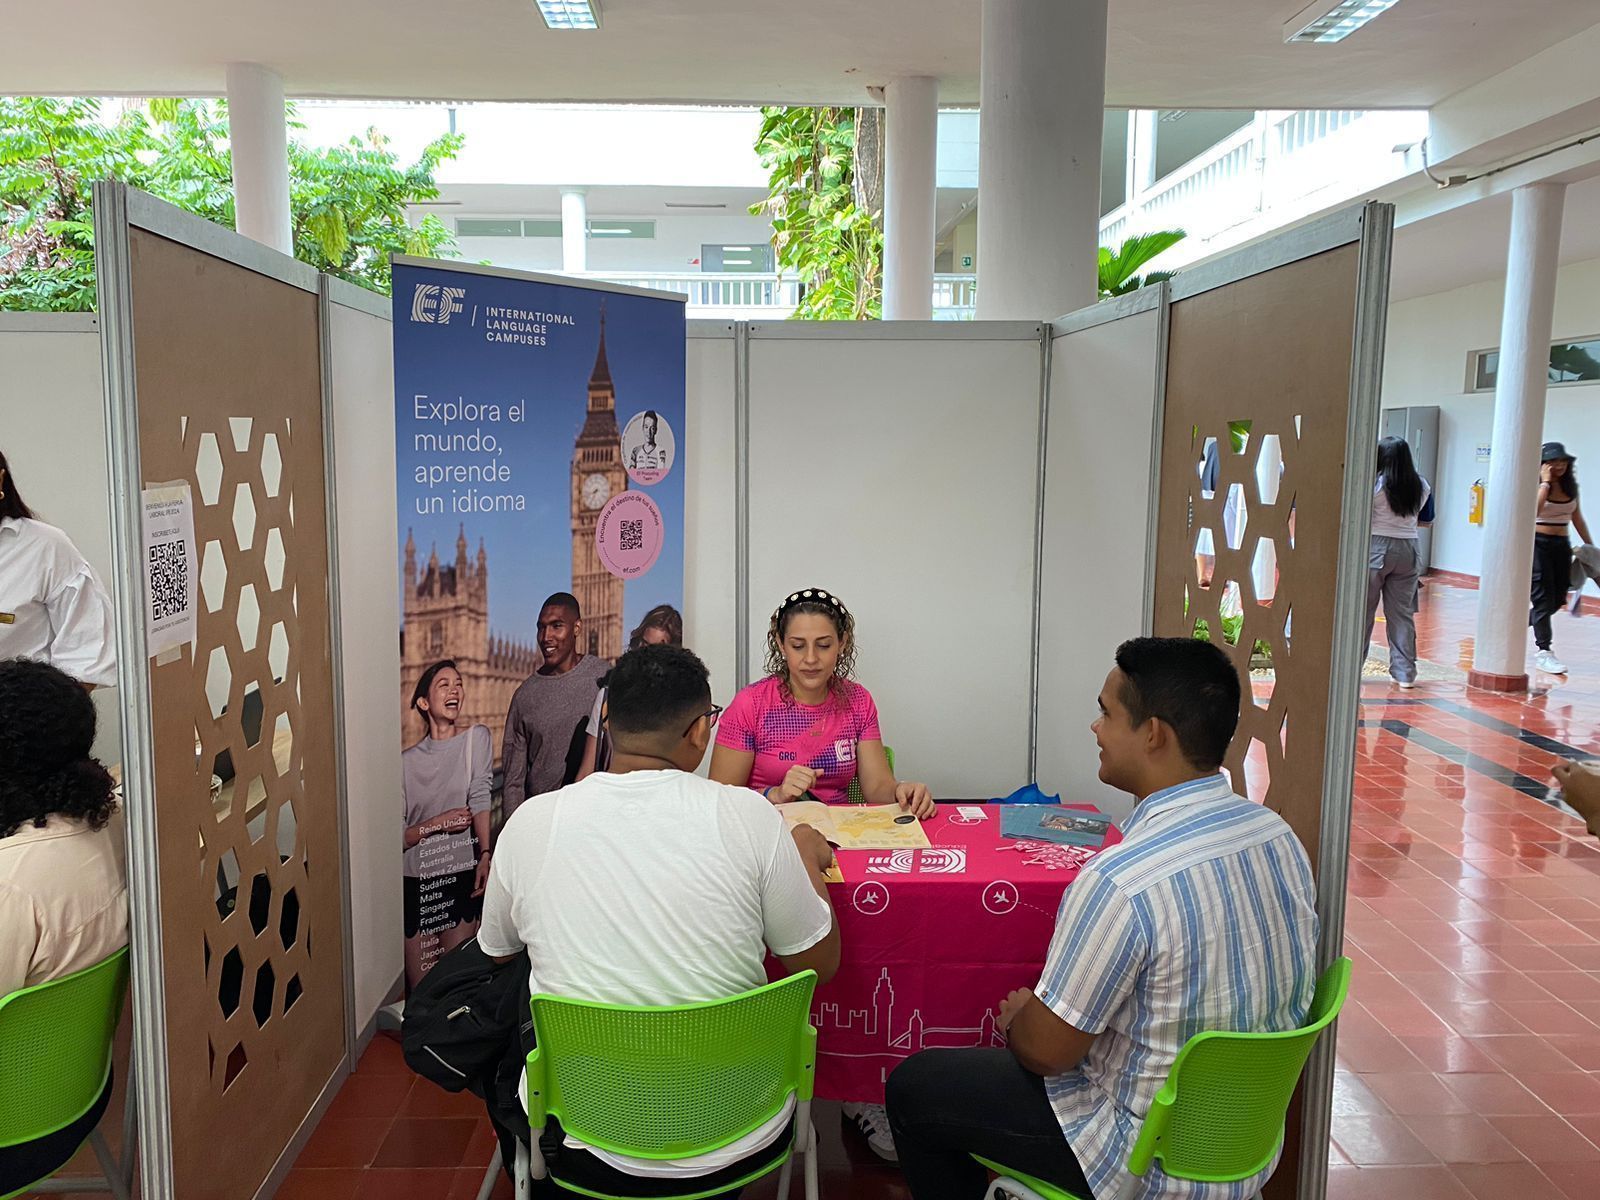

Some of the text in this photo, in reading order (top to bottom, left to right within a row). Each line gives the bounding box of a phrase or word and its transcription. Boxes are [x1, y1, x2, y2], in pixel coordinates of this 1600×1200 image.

[410, 283, 466, 325] EF
[486, 307, 575, 325] INTERNATIONAL
[486, 320, 547, 334] LANGUAGE
[486, 332, 547, 346] CAMPUSES
[414, 395, 525, 426] Explora el
[414, 427, 503, 456] mundo,
[414, 458, 510, 489] aprende
[416, 489, 526, 514] un idioma
[599, 510, 612, 543] Encuentra
[615, 495, 635, 506] destino
[622, 566, 641, 574] ef.com
[419, 816, 467, 836] Reino Unido
[419, 832, 450, 846] Canadá
[419, 836, 479, 858] Estados Unidos
[419, 853, 454, 869] Australia
[419, 859, 478, 881] Nueva Zelanda
[420, 876, 457, 893] Sudáfrica
[420, 891, 443, 904] Malta
[420, 899, 455, 916] Singapur
[420, 911, 449, 927] Francia
[420, 920, 457, 938] Alemania
[420, 936, 440, 949] Italia
[420, 946, 445, 961] Japón
